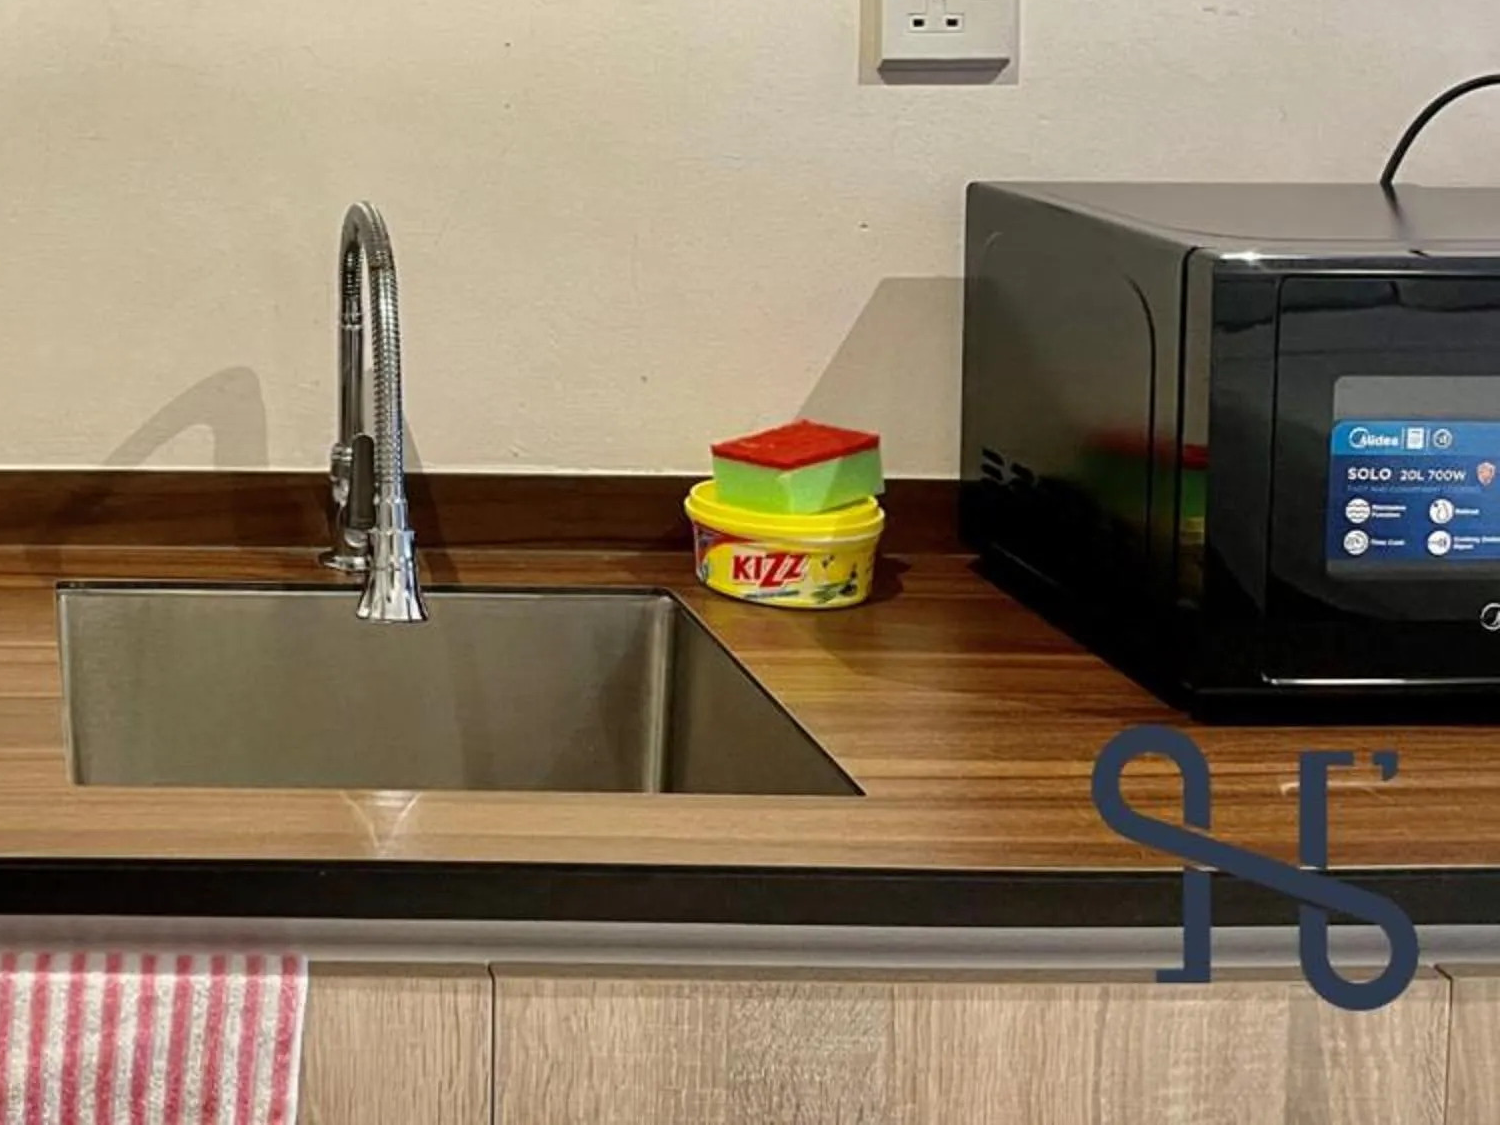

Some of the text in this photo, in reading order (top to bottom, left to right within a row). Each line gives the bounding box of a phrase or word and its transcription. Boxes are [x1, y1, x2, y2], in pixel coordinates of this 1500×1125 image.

[1347, 467, 1466, 482] SOLO 20L 700W
[732, 552, 807, 588] KIZZ
